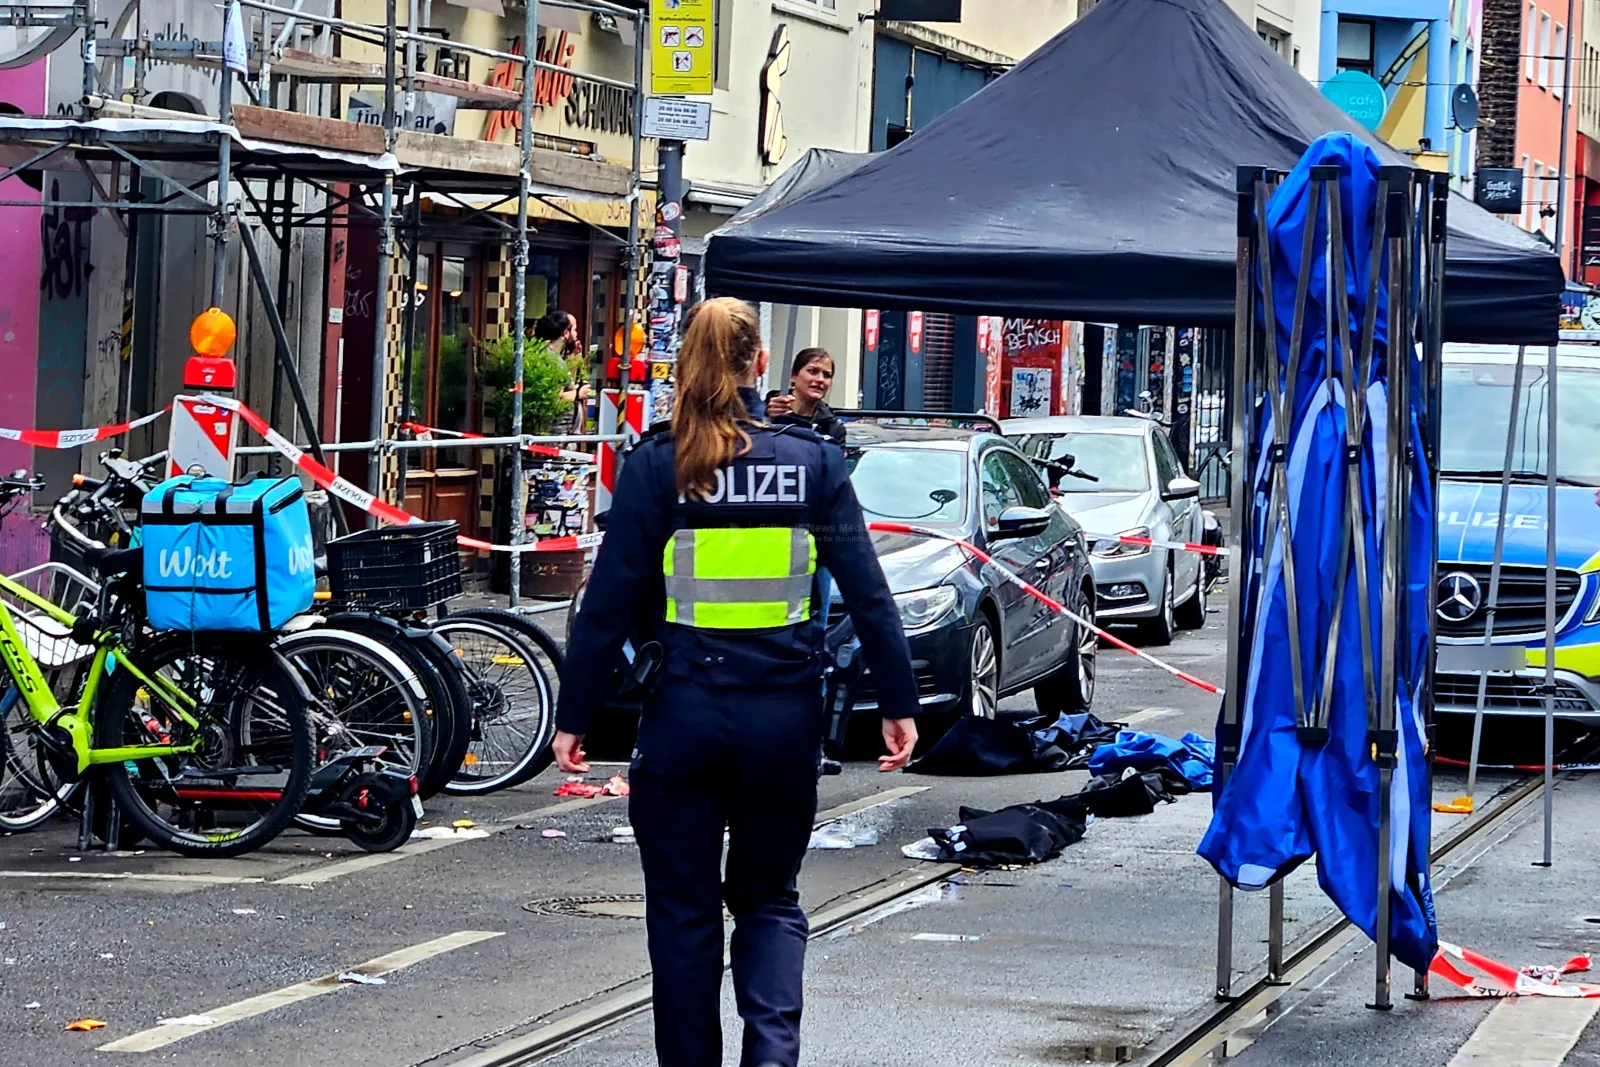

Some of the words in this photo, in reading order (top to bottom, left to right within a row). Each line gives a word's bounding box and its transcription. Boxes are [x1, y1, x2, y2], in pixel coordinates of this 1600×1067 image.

[1004, 328, 1060, 350] BENSCH
[678, 465, 806, 504] OLIZEI
[159, 546, 233, 579] Wolt
